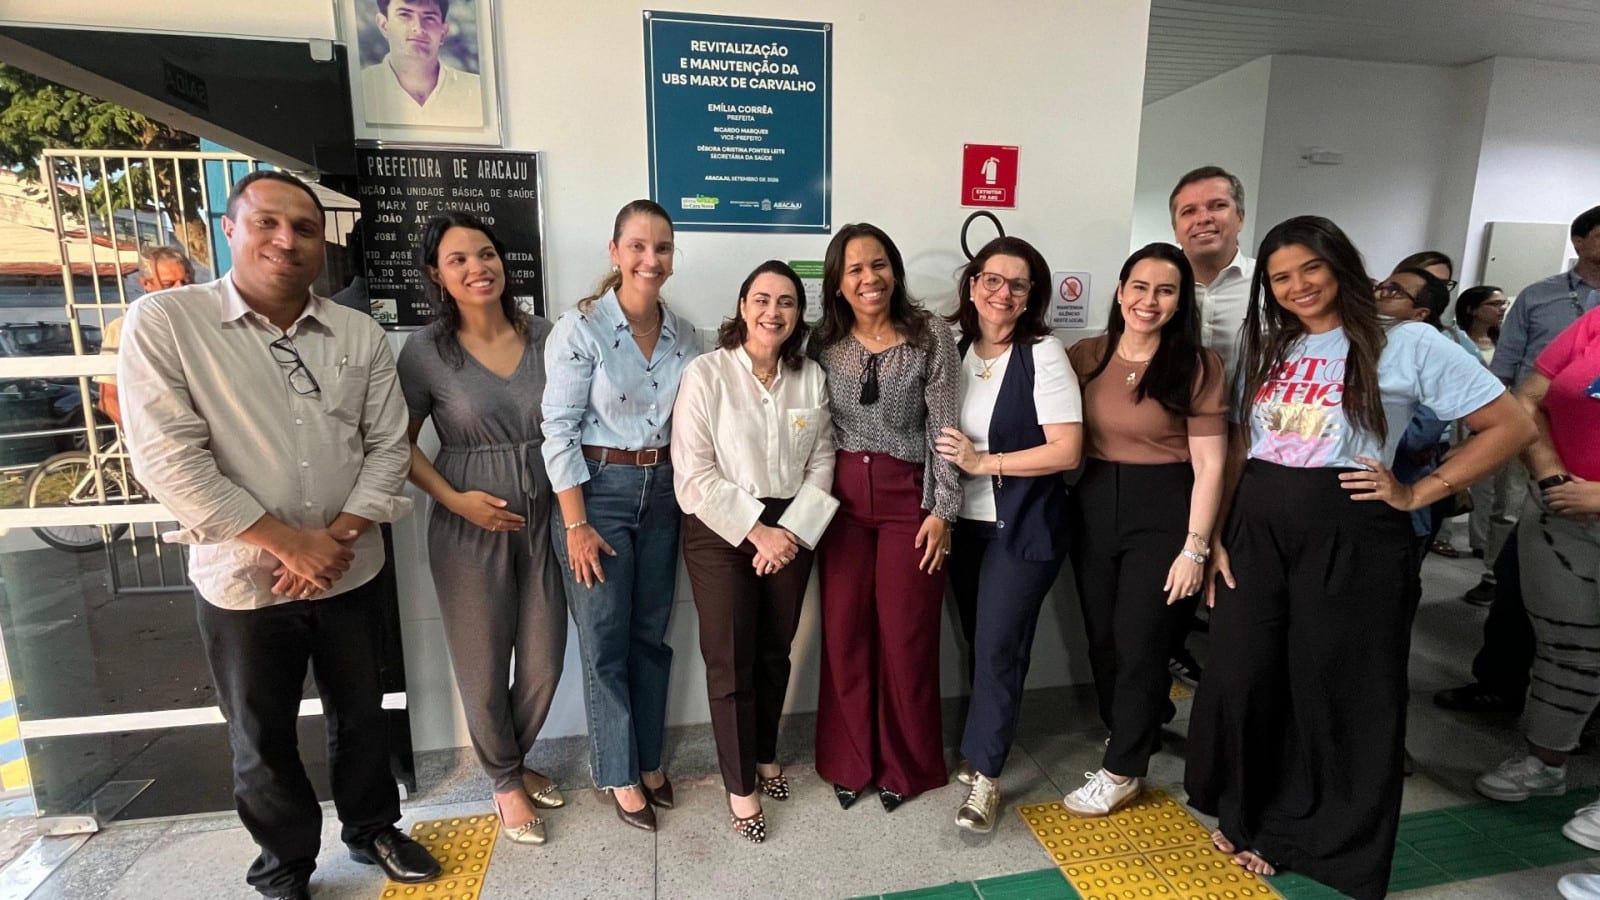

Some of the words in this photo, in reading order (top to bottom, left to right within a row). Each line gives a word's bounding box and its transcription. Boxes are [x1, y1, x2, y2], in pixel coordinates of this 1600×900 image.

[691, 40, 788, 59] REVITALIZAÇÃO
[680, 58, 688, 68] E
[690, 58, 779, 76] MANUTENÇÃO
[782, 64, 799, 75] DA
[662, 73, 687, 85] UBS
[690, 75, 728, 87] MARX
[731, 77, 747, 88] DE
[749, 78, 816, 92] CARVALHO
[708, 102, 737, 113] EMÍLIA
[738, 104, 773, 115] CORRÊA
[367, 156, 442, 178] PREFEITURA
[453, 158, 468, 179] DE
[478, 159, 528, 180] ARACAJU
[390, 187, 402, 196] DA
[406, 187, 445, 197] UNIDADE
[452, 186, 484, 198] BÁSICA
[490, 188, 501, 198] DE
[507, 187, 536, 199] SAÚDE
[377, 201, 407, 210] MARX
[416, 201, 429, 211] DE
[437, 201, 490, 212] CARVALHO
[375, 213, 403, 224] JOÃO
[390, 249, 413, 260] JOSÉ
[382, 269, 394, 277] DO
